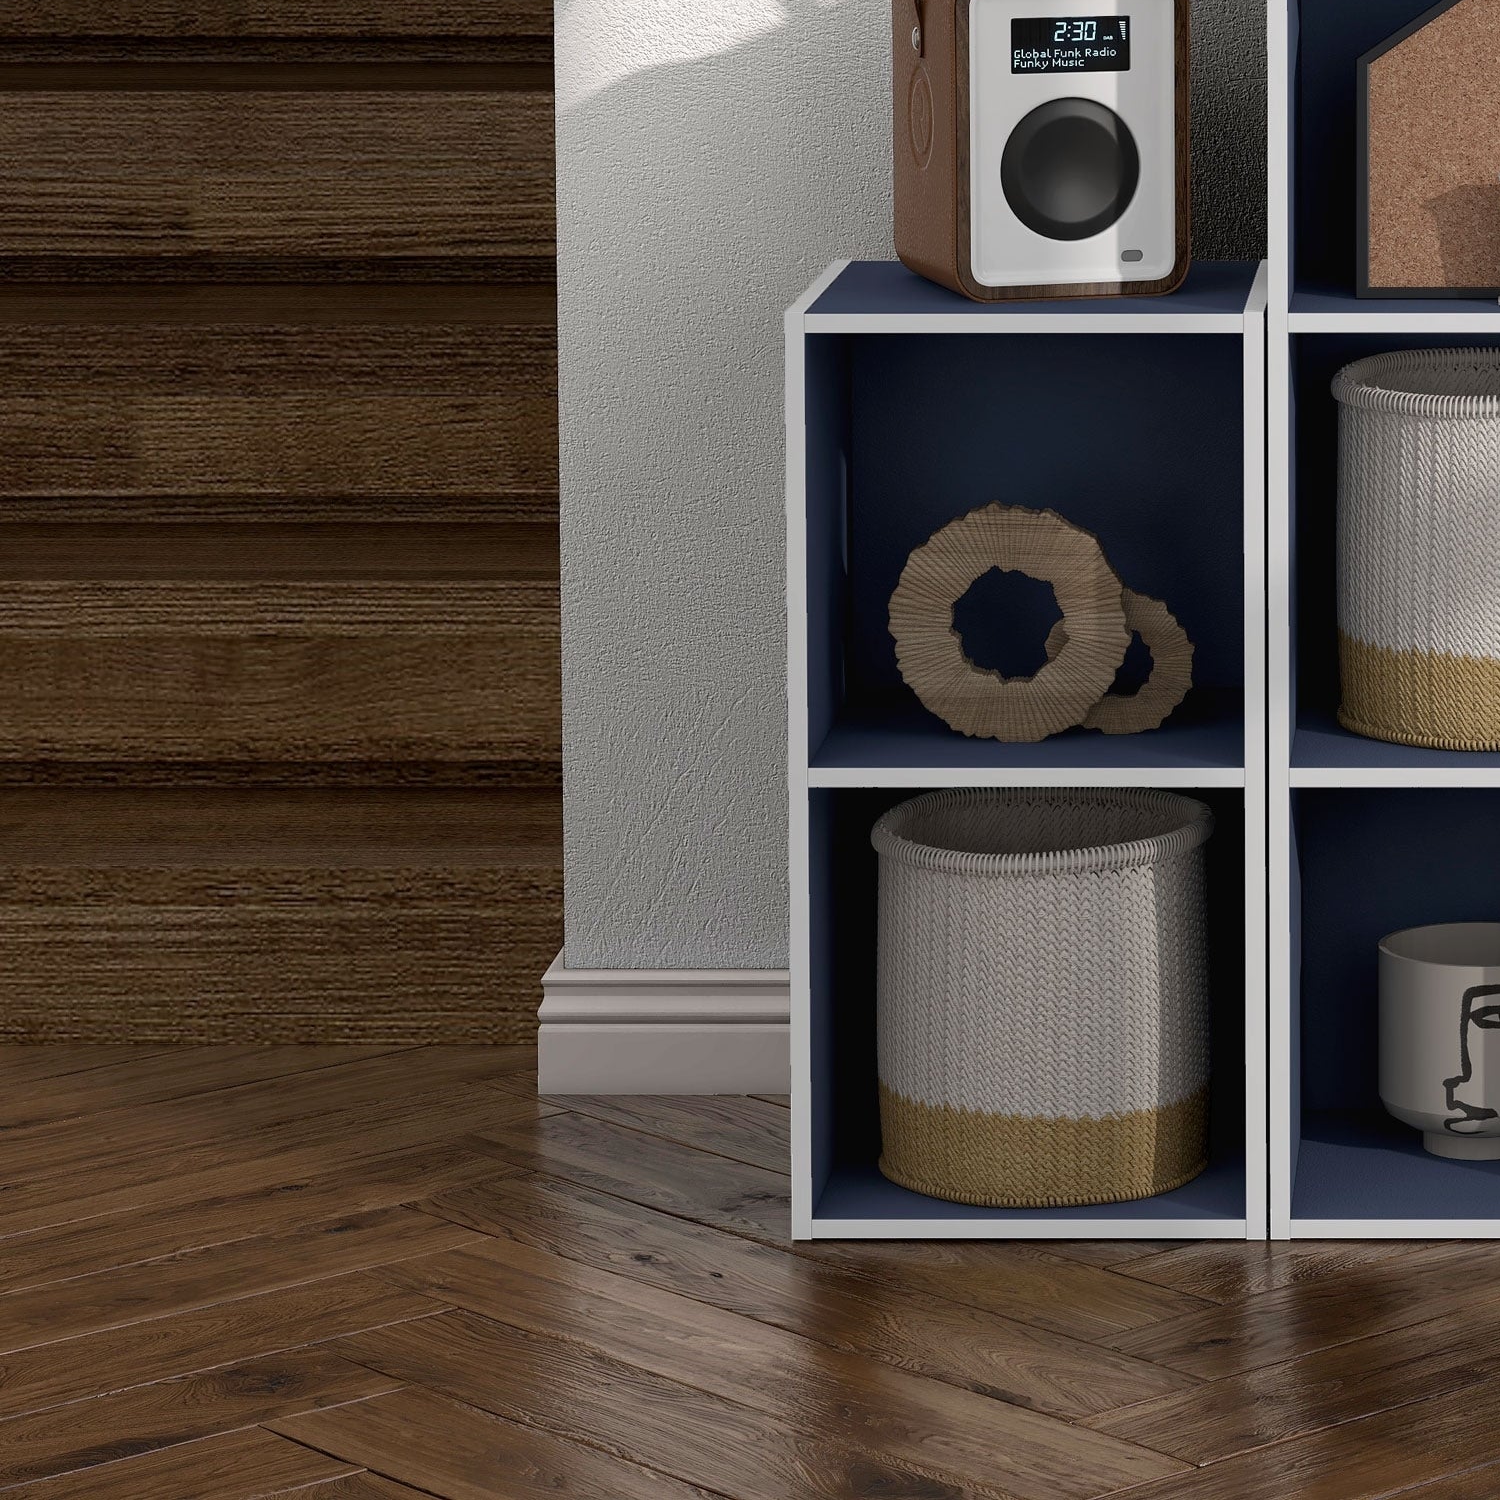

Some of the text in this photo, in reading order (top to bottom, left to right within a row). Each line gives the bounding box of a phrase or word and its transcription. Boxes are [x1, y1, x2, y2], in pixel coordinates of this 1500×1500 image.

[1054, 21, 1097, 41] 2:30
[1013, 47, 1117, 59] Global Funk Radio
[1013, 58, 1085, 70] Funky Music
